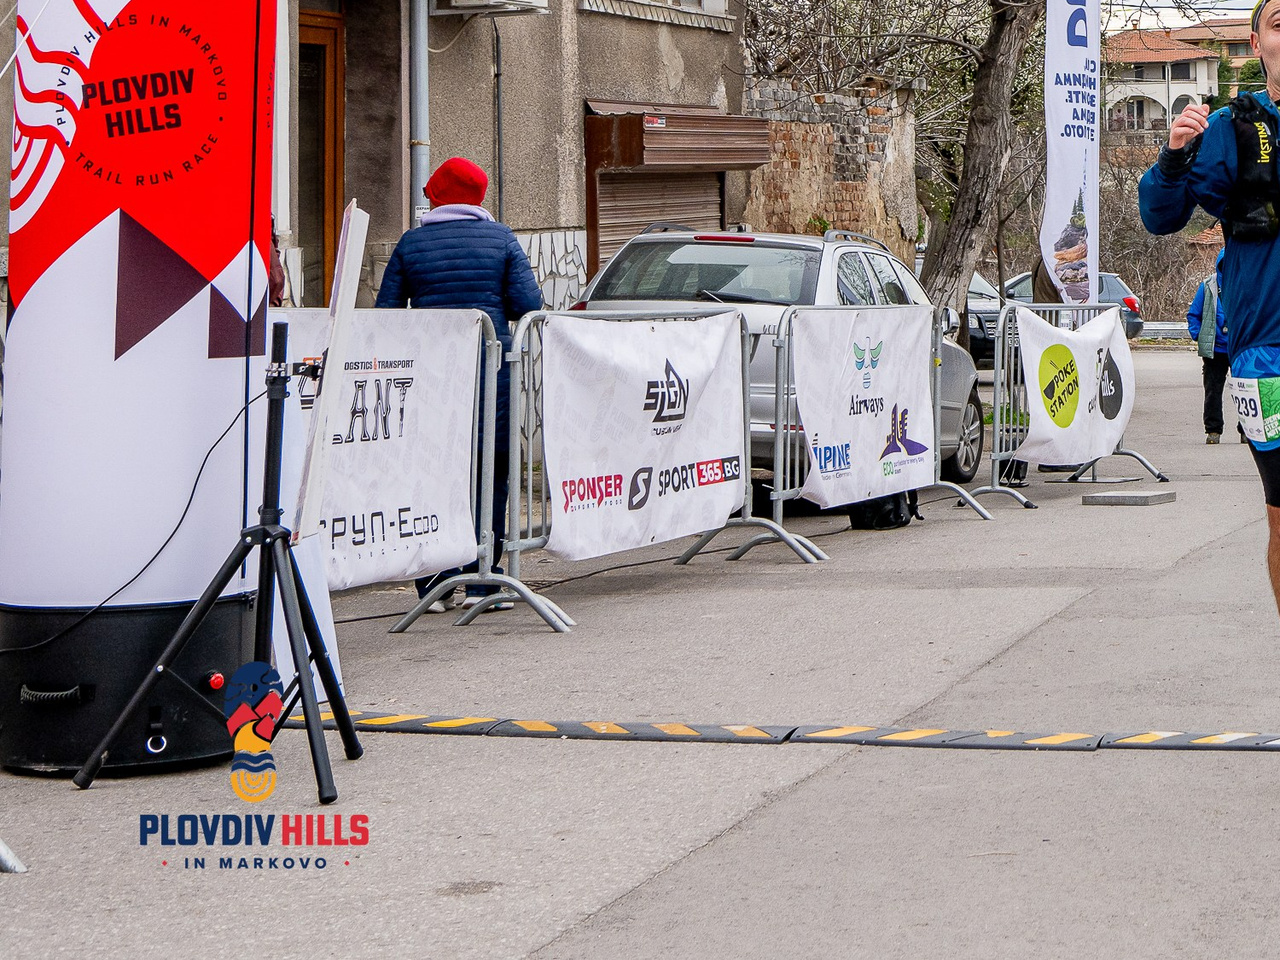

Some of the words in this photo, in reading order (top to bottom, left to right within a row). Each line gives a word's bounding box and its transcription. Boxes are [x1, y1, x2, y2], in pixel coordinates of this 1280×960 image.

[55, 46, 80, 126] PLOVDIV
[84, 14, 138, 43] HILLS
[151, 14, 170, 28] IN
[179, 24, 228, 101] MARKOVO
[82, 68, 195, 109] PLOVDIV
[105, 103, 182, 138] HILLS
[75, 152, 122, 185] TRAIL
[136, 170, 174, 186] RUN
[182, 133, 218, 172] RACE
[378, 359, 415, 370] TRANSPORT
[1054, 359, 1076, 388] POKE
[849, 394, 884, 417] Airways
[1050, 376, 1079, 418] STATION
[562, 474, 623, 514] SPONSER
